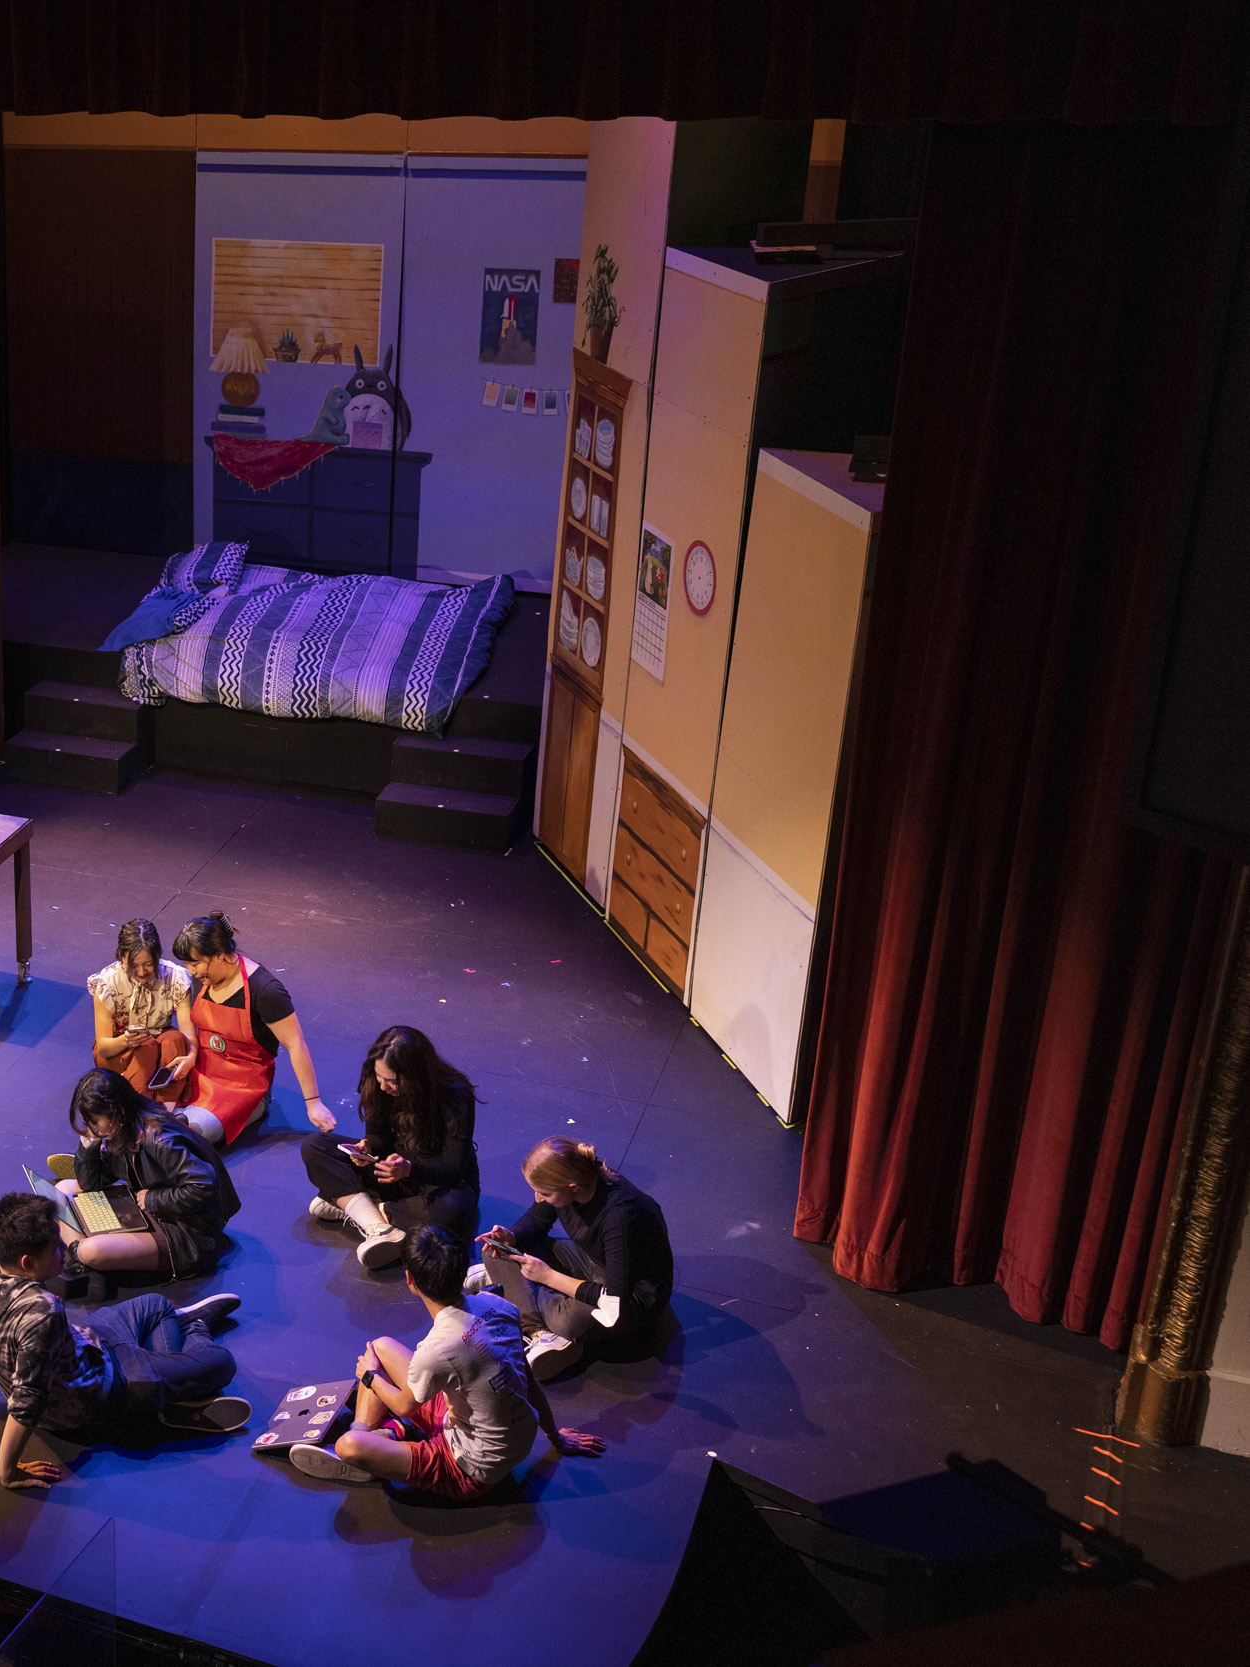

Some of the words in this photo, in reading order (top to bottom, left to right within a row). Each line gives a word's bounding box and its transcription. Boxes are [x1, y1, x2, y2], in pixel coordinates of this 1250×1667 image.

[485, 274, 540, 293] NASA
[462, 1318, 482, 1344] picoCTF
[482, 1307, 497, 1322] 2019
